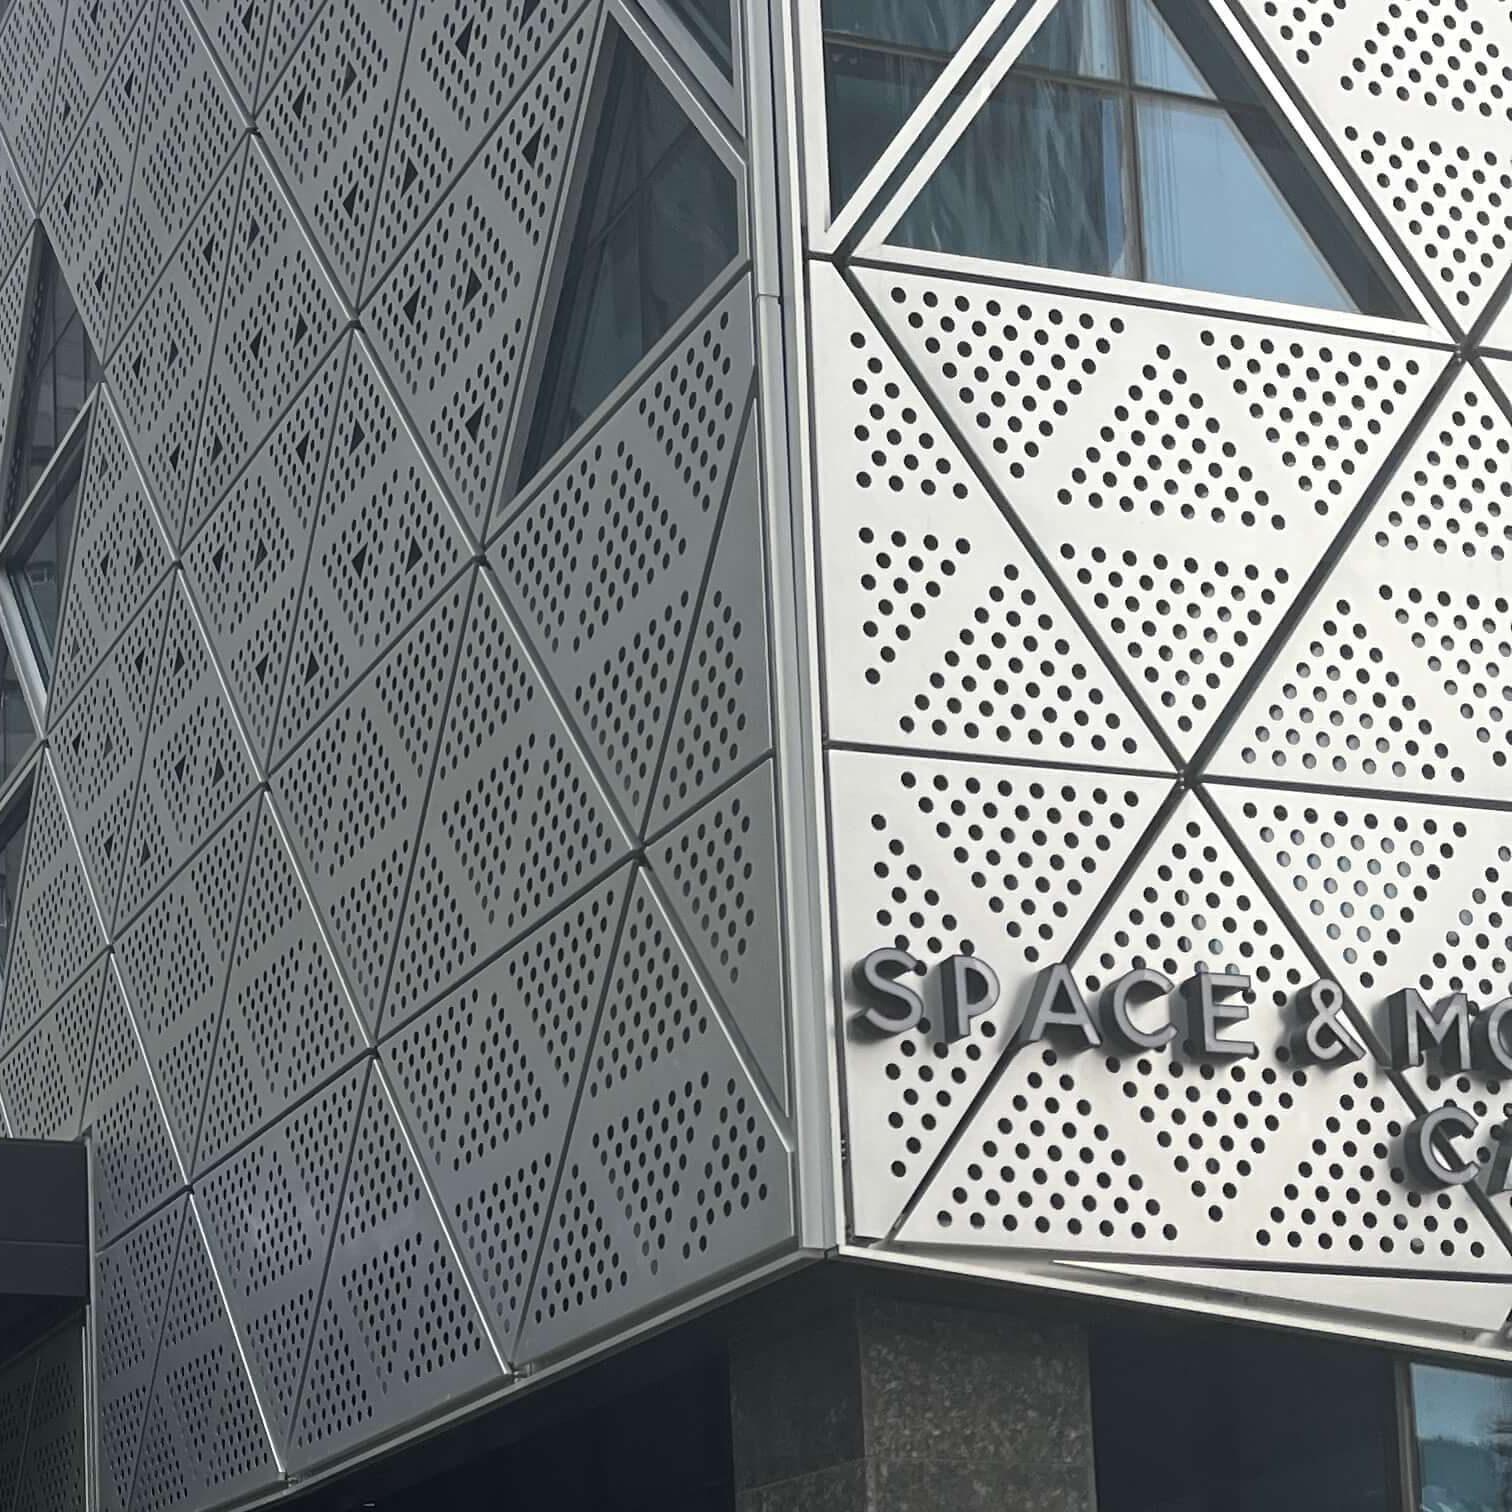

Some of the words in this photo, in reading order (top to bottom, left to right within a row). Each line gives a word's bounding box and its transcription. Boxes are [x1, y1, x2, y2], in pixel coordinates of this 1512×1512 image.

[854, 946, 1255, 1057] SPACE
[1297, 978, 1366, 1064] &
[1408, 1106, 1512, 1193] C
